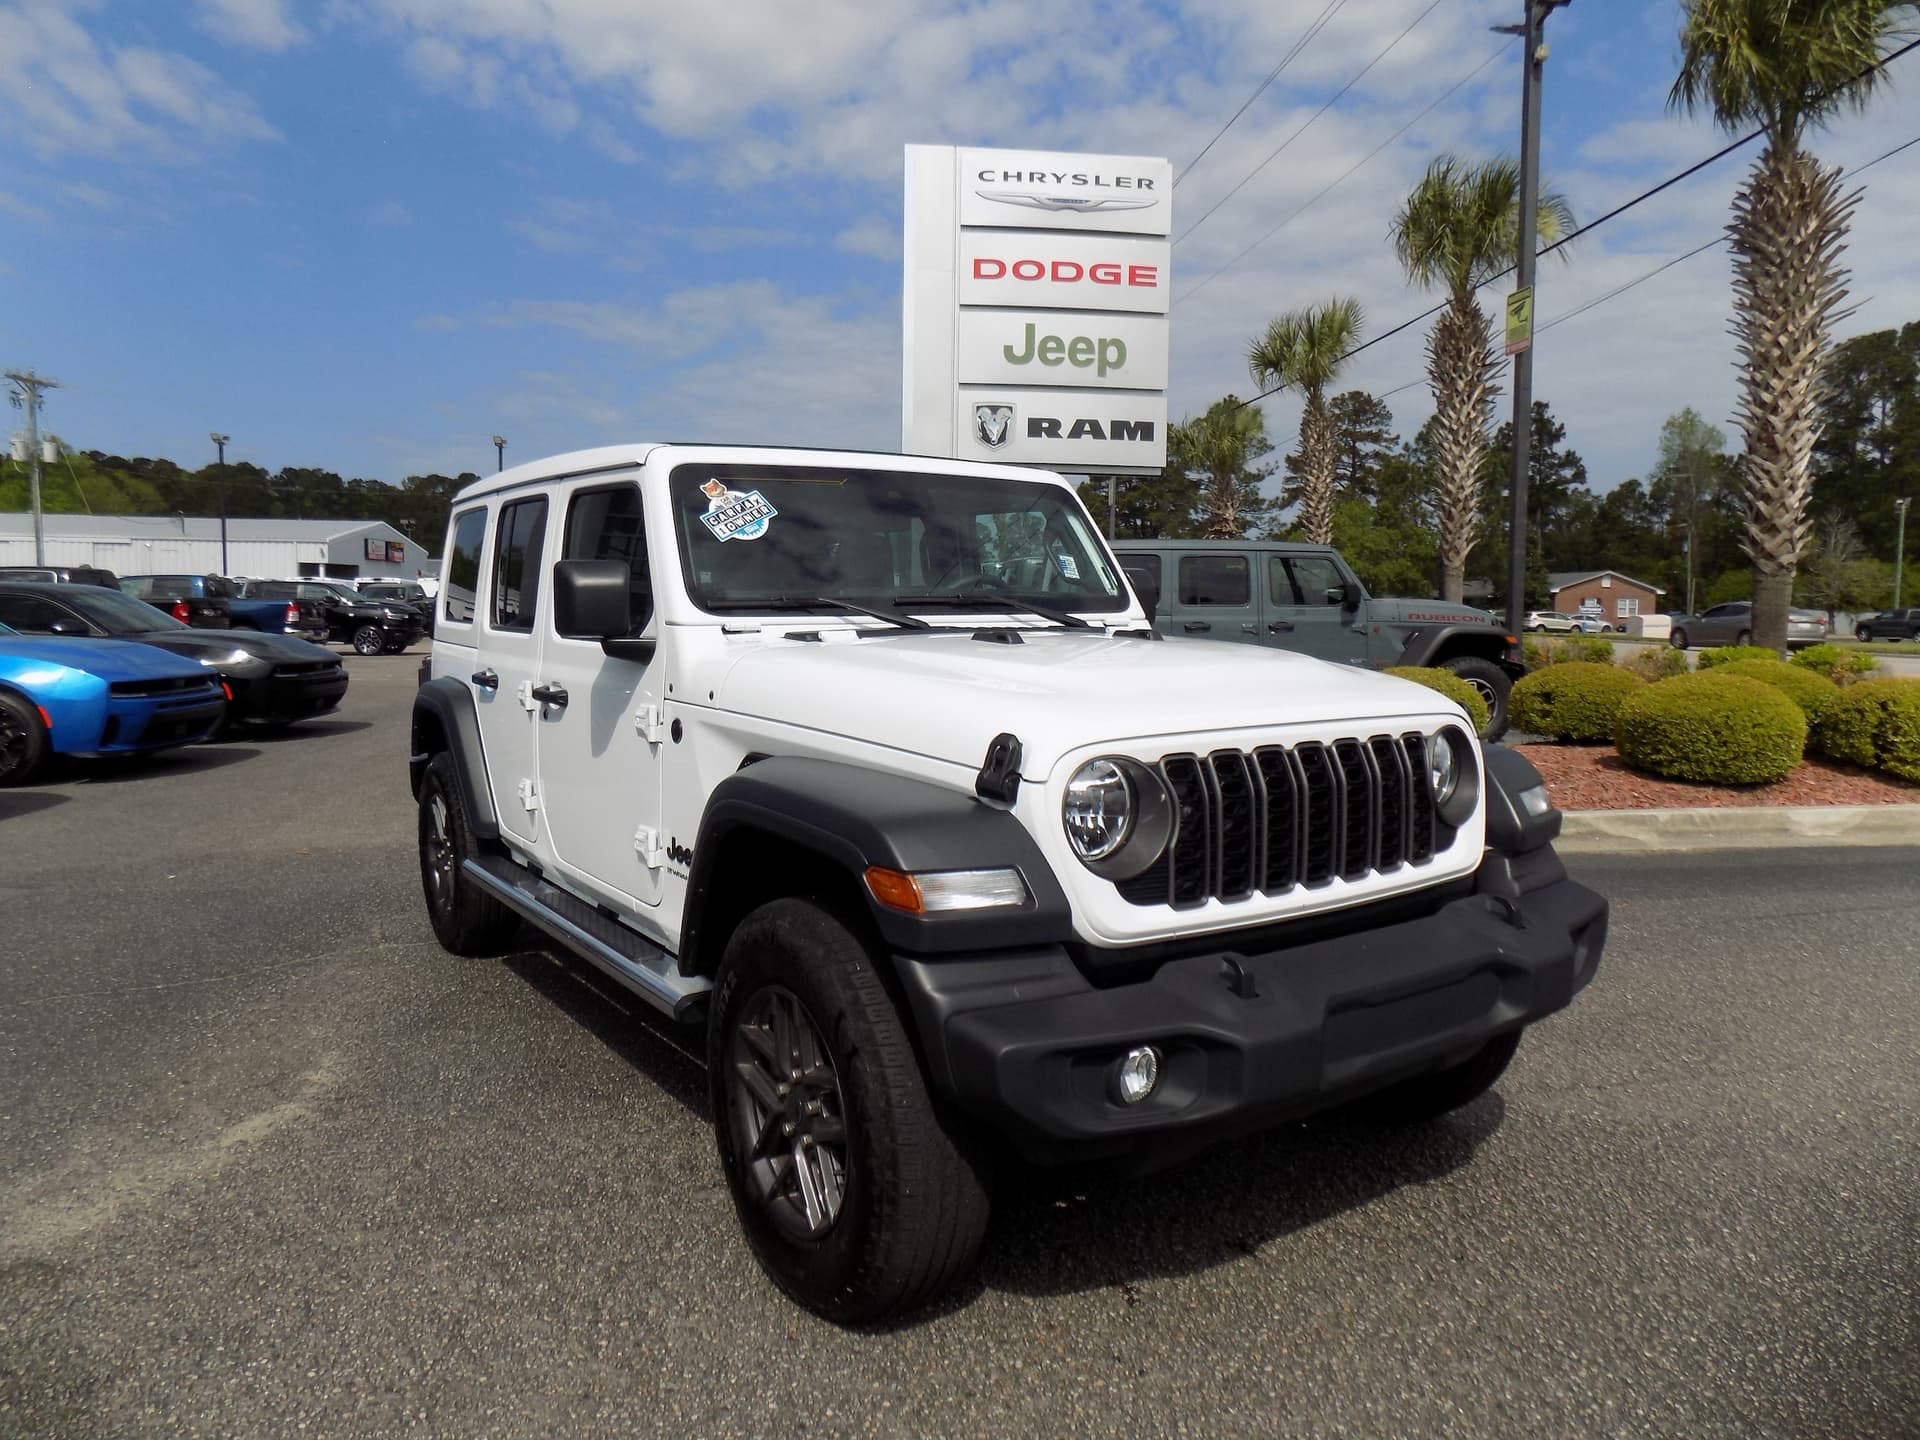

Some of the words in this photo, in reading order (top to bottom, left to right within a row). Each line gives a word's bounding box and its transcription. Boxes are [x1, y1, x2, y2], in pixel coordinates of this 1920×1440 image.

[977, 170, 1154, 190] CHRYSLER
[973, 258, 1158, 287] DODGE
[1003, 323, 1127, 378] Jeep
[1027, 417, 1155, 442] RAM
[708, 497, 761, 527] CARFAX
[1407, 613, 1485, 623] RUBICON
[666, 836, 693, 868] Jee
